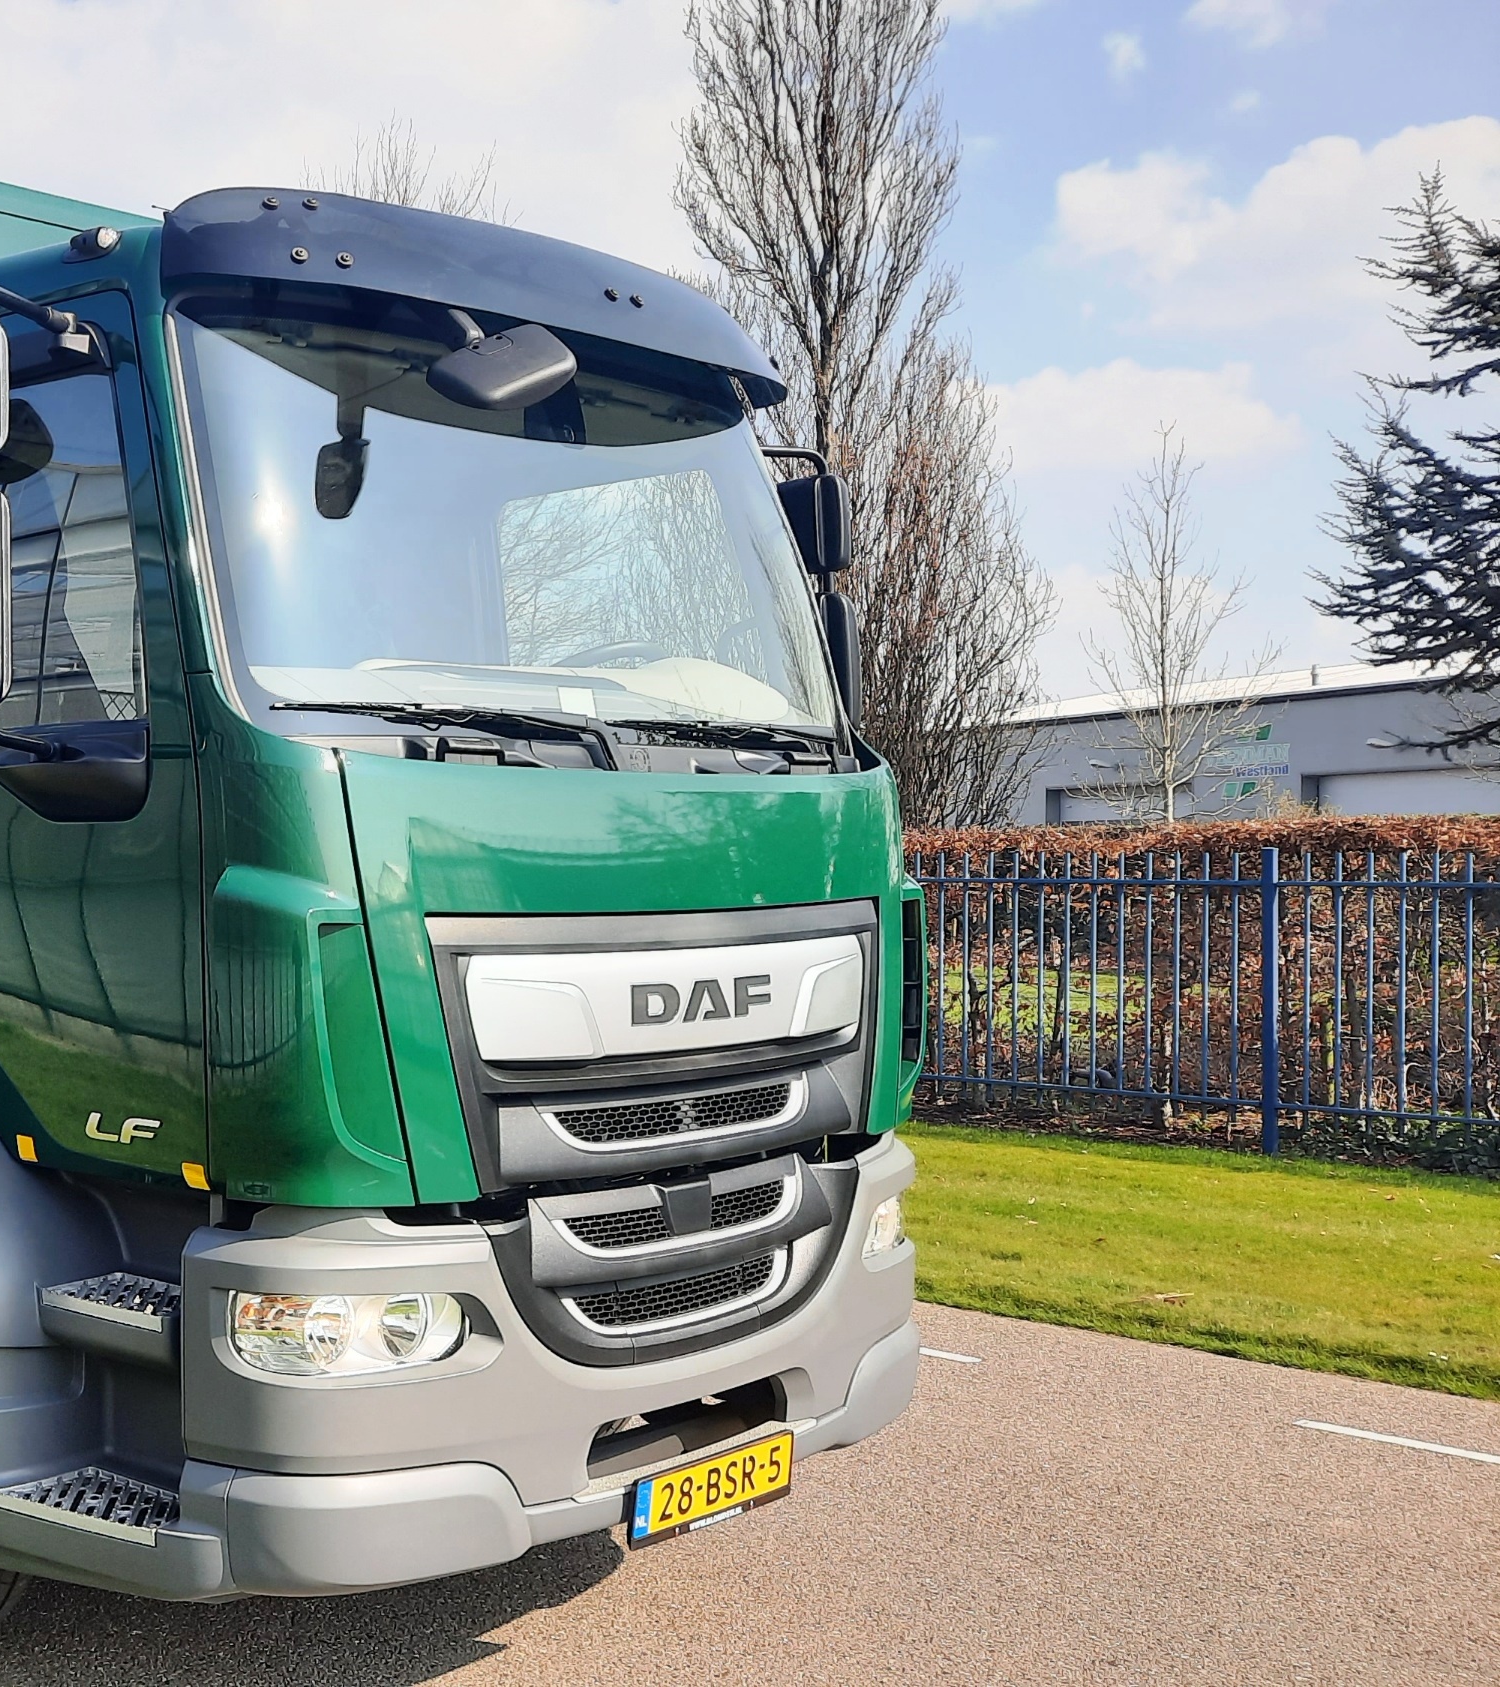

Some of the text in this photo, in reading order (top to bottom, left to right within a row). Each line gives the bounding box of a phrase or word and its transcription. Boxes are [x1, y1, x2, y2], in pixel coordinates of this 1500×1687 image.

[1235, 764, 1289, 777] Westland
[631, 974, 771, 1026] DAF
[85, 1112, 161, 1144] LF
[658, 1445, 781, 1523] 28-BSR-5
[634, 1515, 648, 1529] NL
